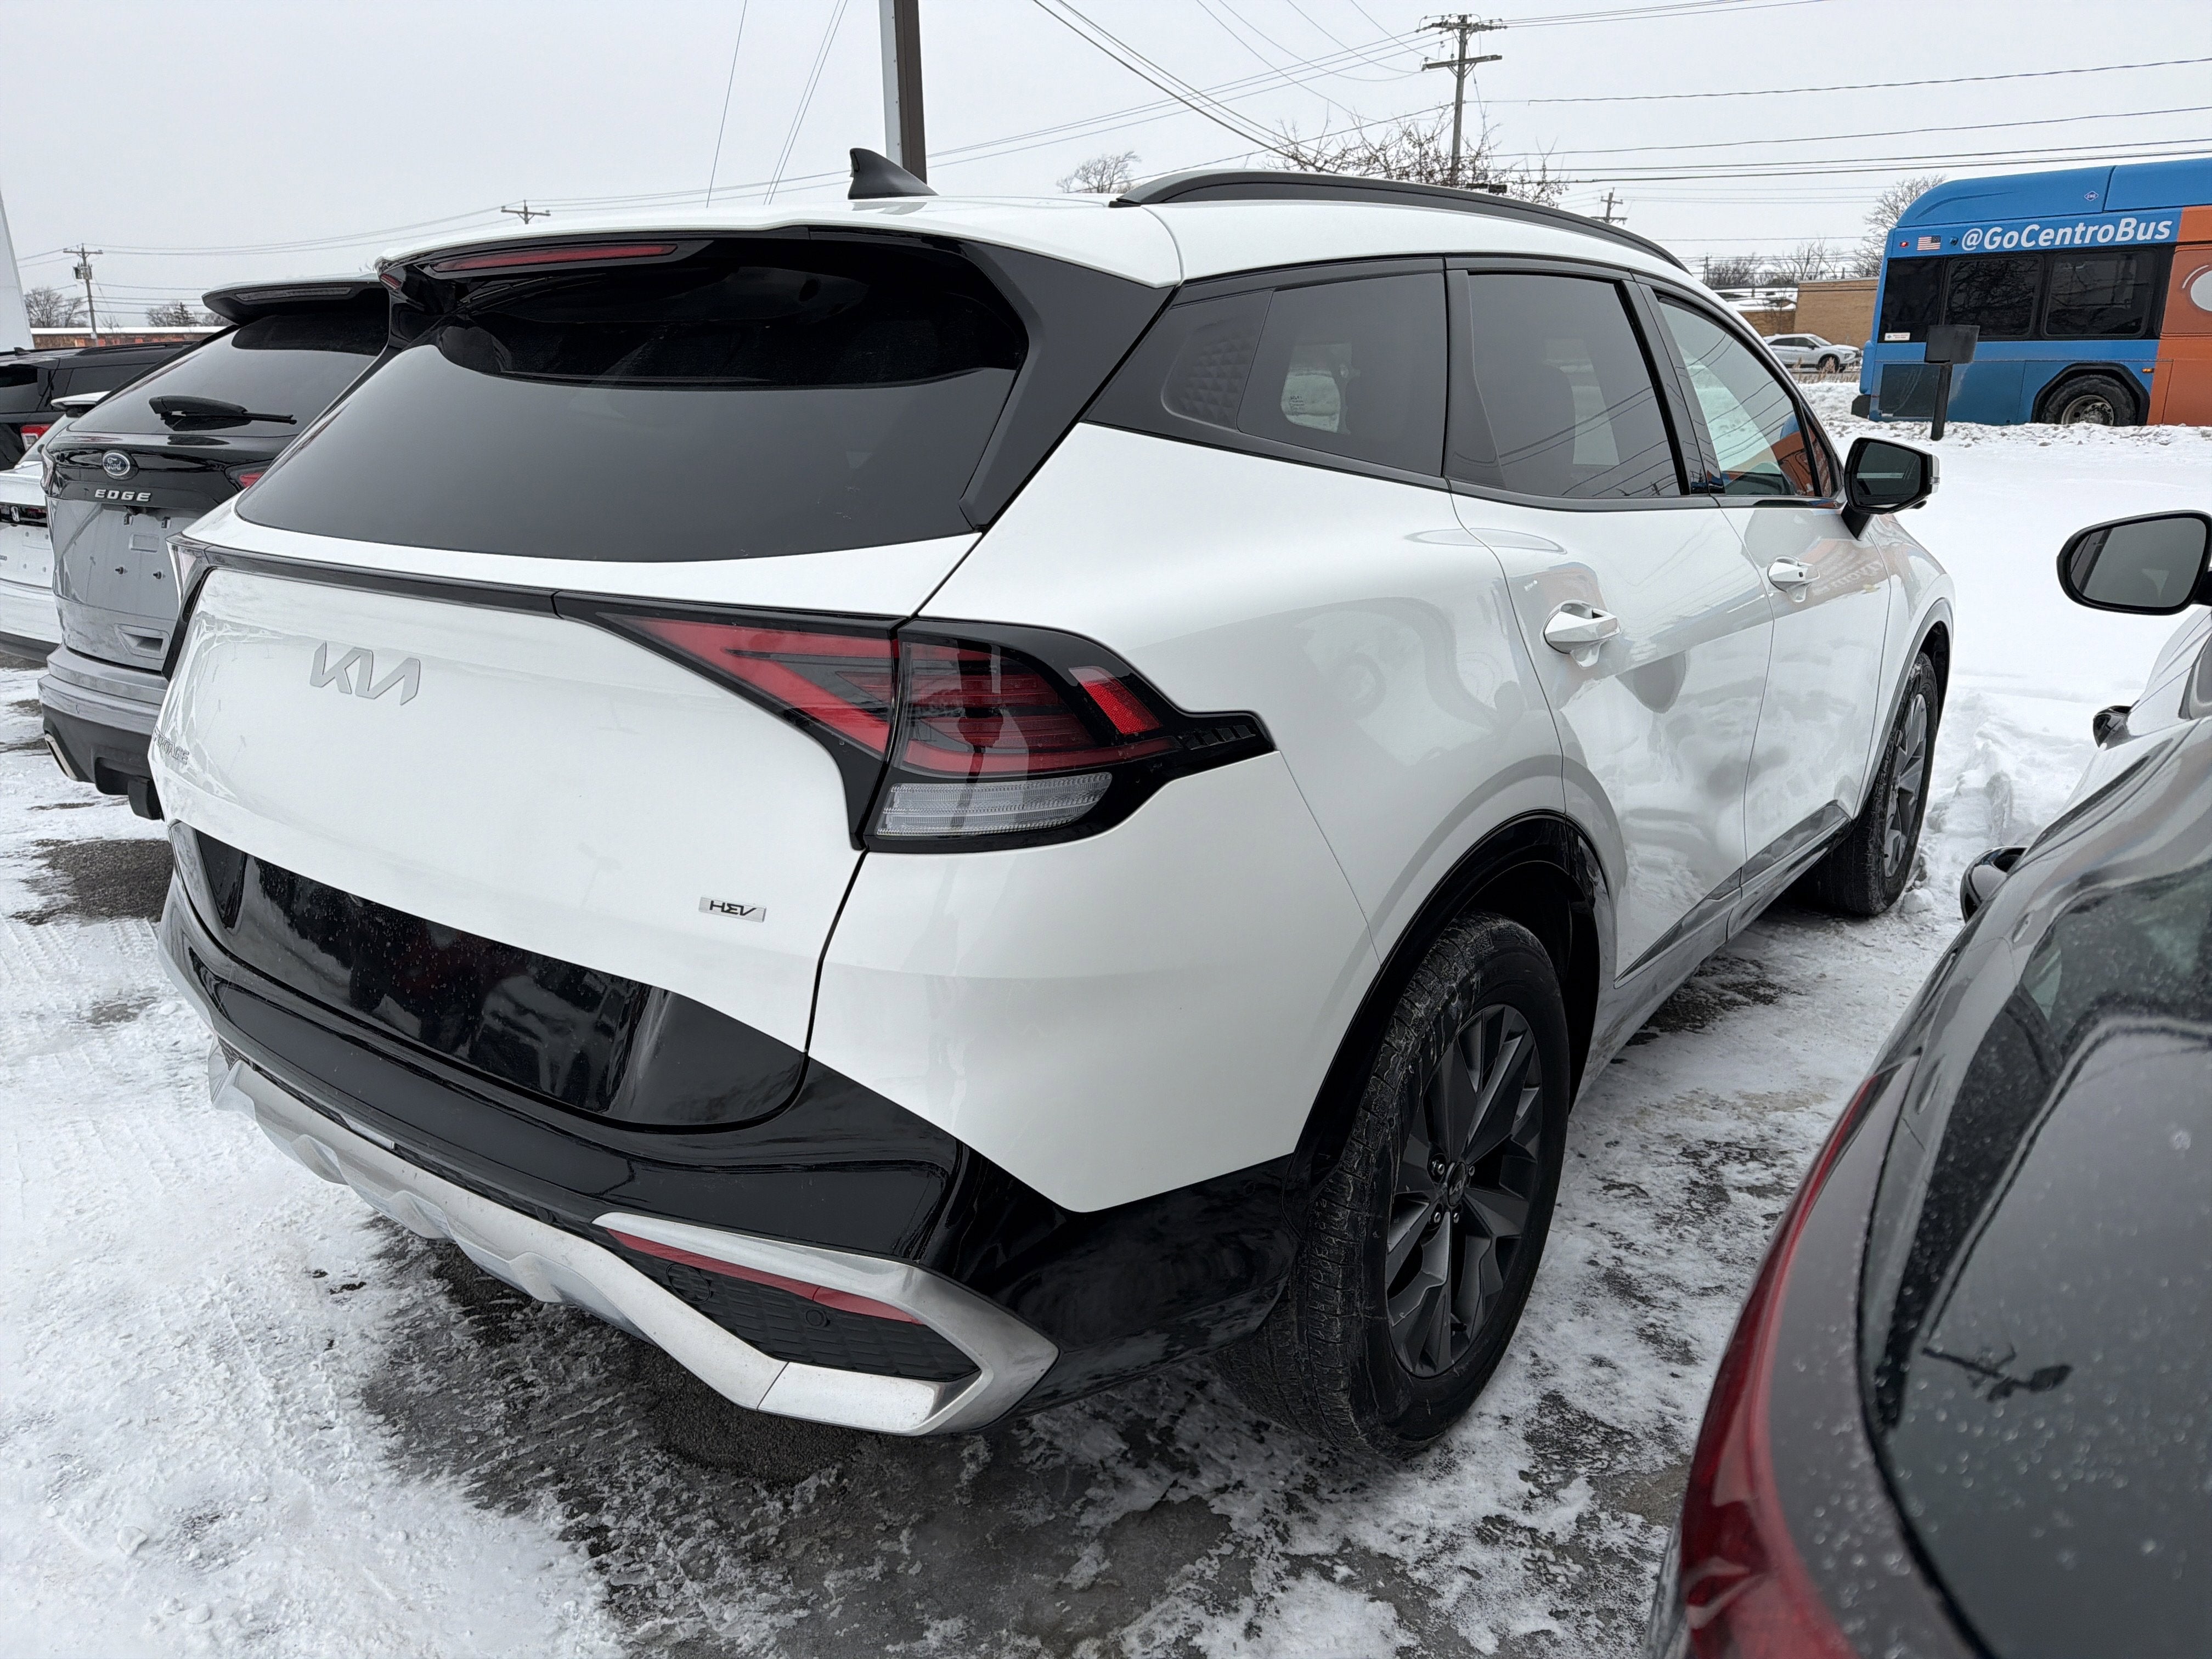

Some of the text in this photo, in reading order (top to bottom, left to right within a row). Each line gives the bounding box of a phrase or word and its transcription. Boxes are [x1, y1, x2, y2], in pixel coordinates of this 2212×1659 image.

[1961, 217, 2172, 251] @GoCentroBus
[106, 457, 121, 470] Ford
[94, 488, 151, 501] EDGE
[309, 641, 421, 706] KIA
[709, 900, 757, 916] HEV
